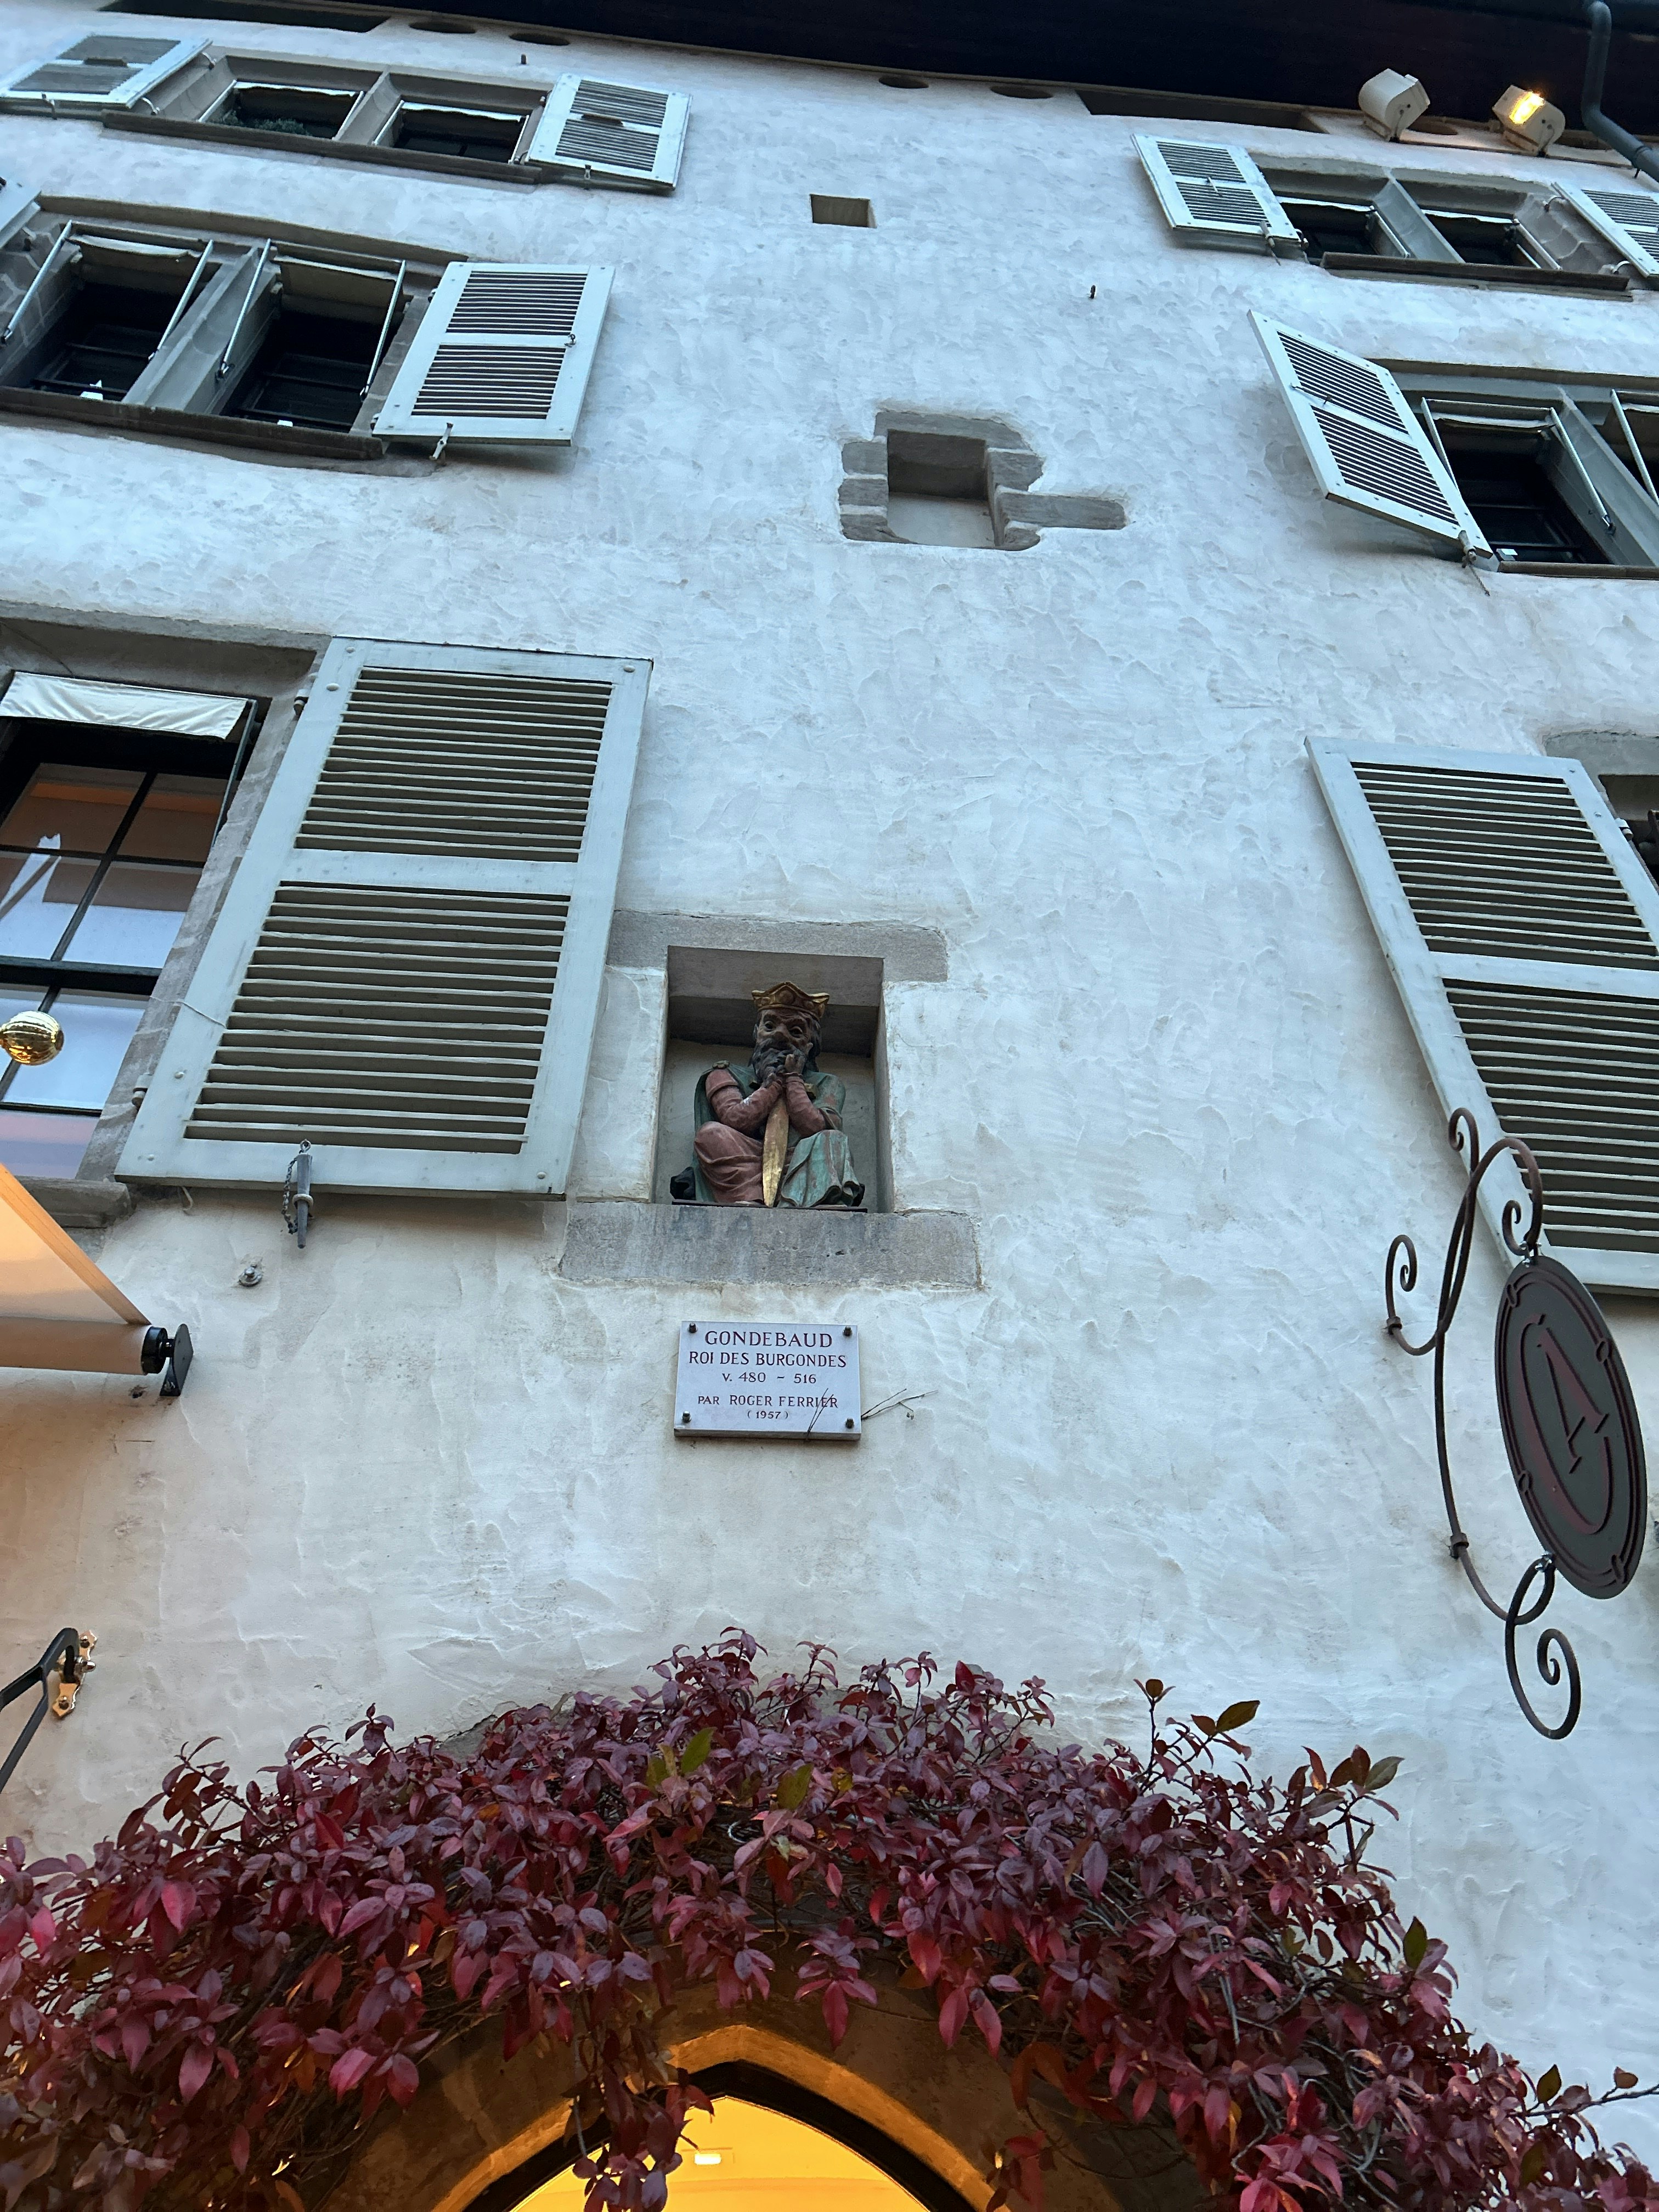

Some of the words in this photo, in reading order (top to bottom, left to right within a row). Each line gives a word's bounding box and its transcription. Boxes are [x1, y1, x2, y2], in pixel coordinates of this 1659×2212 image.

[705, 1330, 832, 1348] GONDEBAUD
[689, 1351, 713, 1364] ROI
[720, 1352, 749, 1365] DES
[755, 1353, 847, 1368] BURGONDES
[738, 1372, 766, 1383] 480
[793, 1374, 817, 1384] 516
[698, 1396, 720, 1405] PAR
[730, 1395, 772, 1407] ROGER
[779, 1396, 838, 1408] FERRIER
